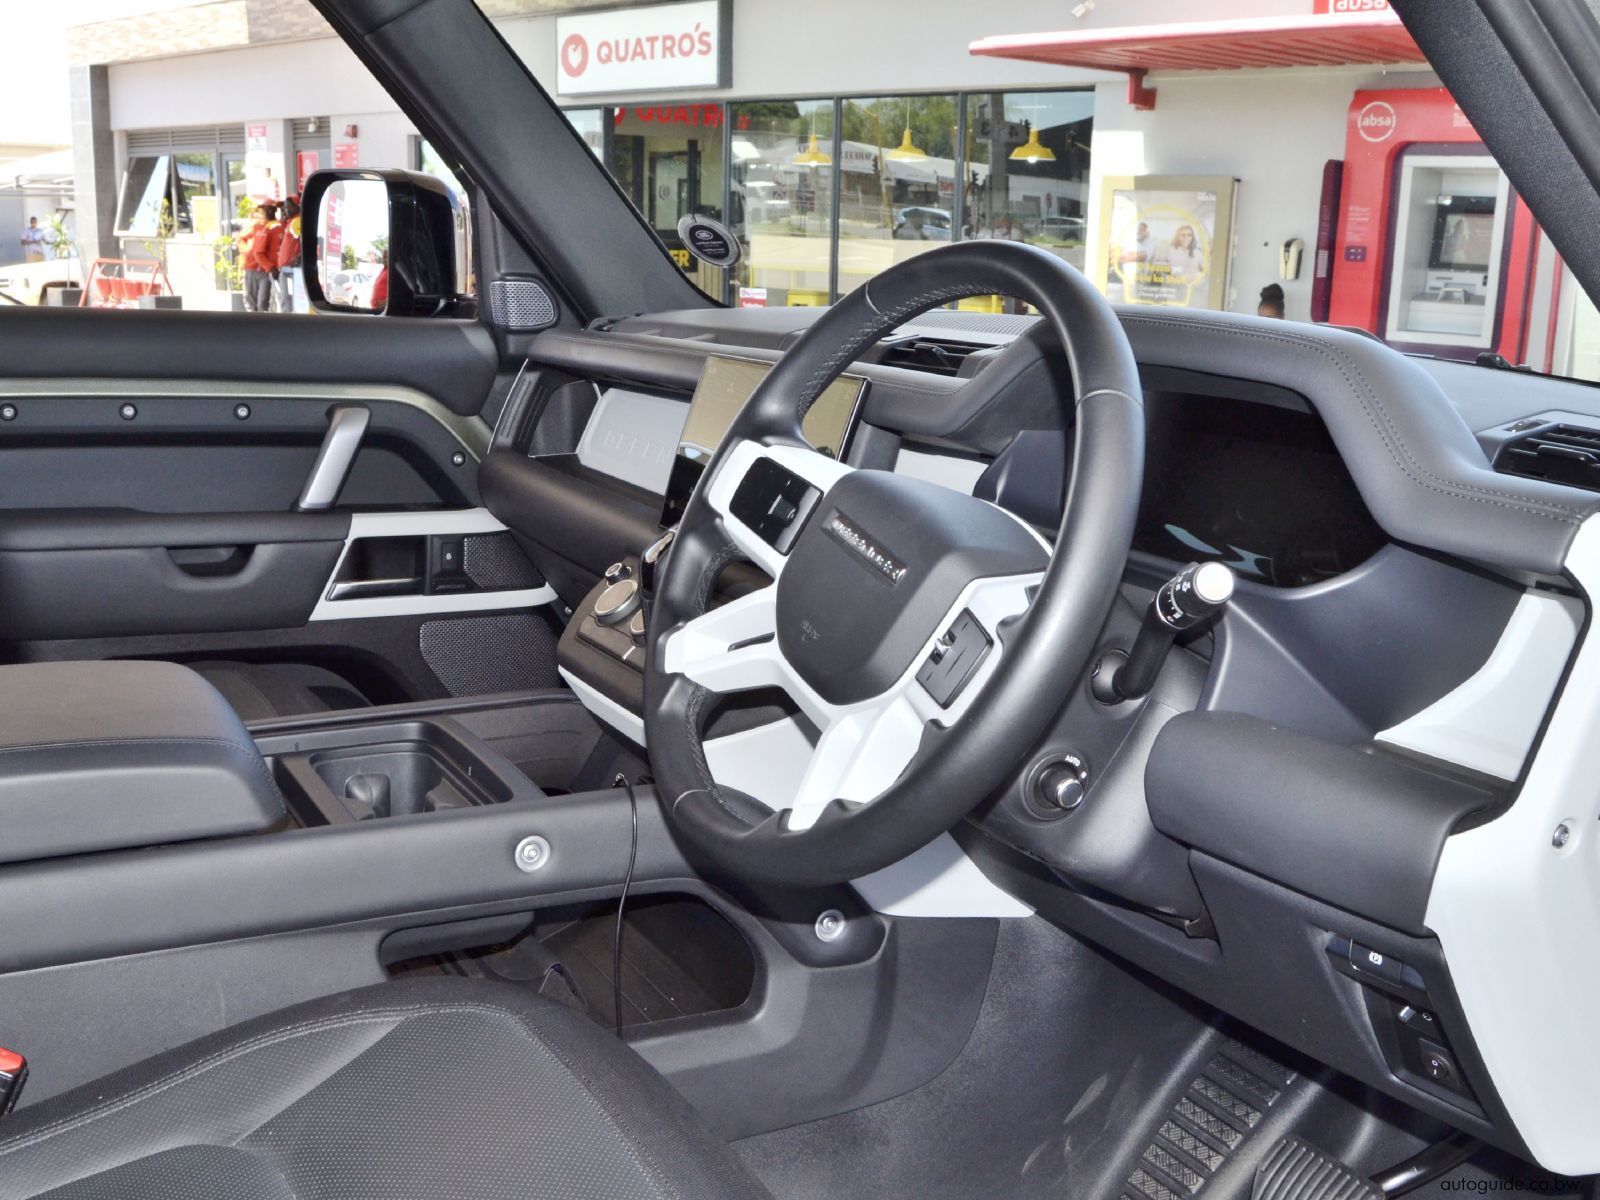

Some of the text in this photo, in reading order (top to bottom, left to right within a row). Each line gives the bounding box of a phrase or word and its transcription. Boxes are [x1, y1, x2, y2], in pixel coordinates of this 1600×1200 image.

[597, 22, 712, 64] QUATRO'S
[1362, 114, 1391, 127] absa
[1065, 754, 1080, 767] AUTO
